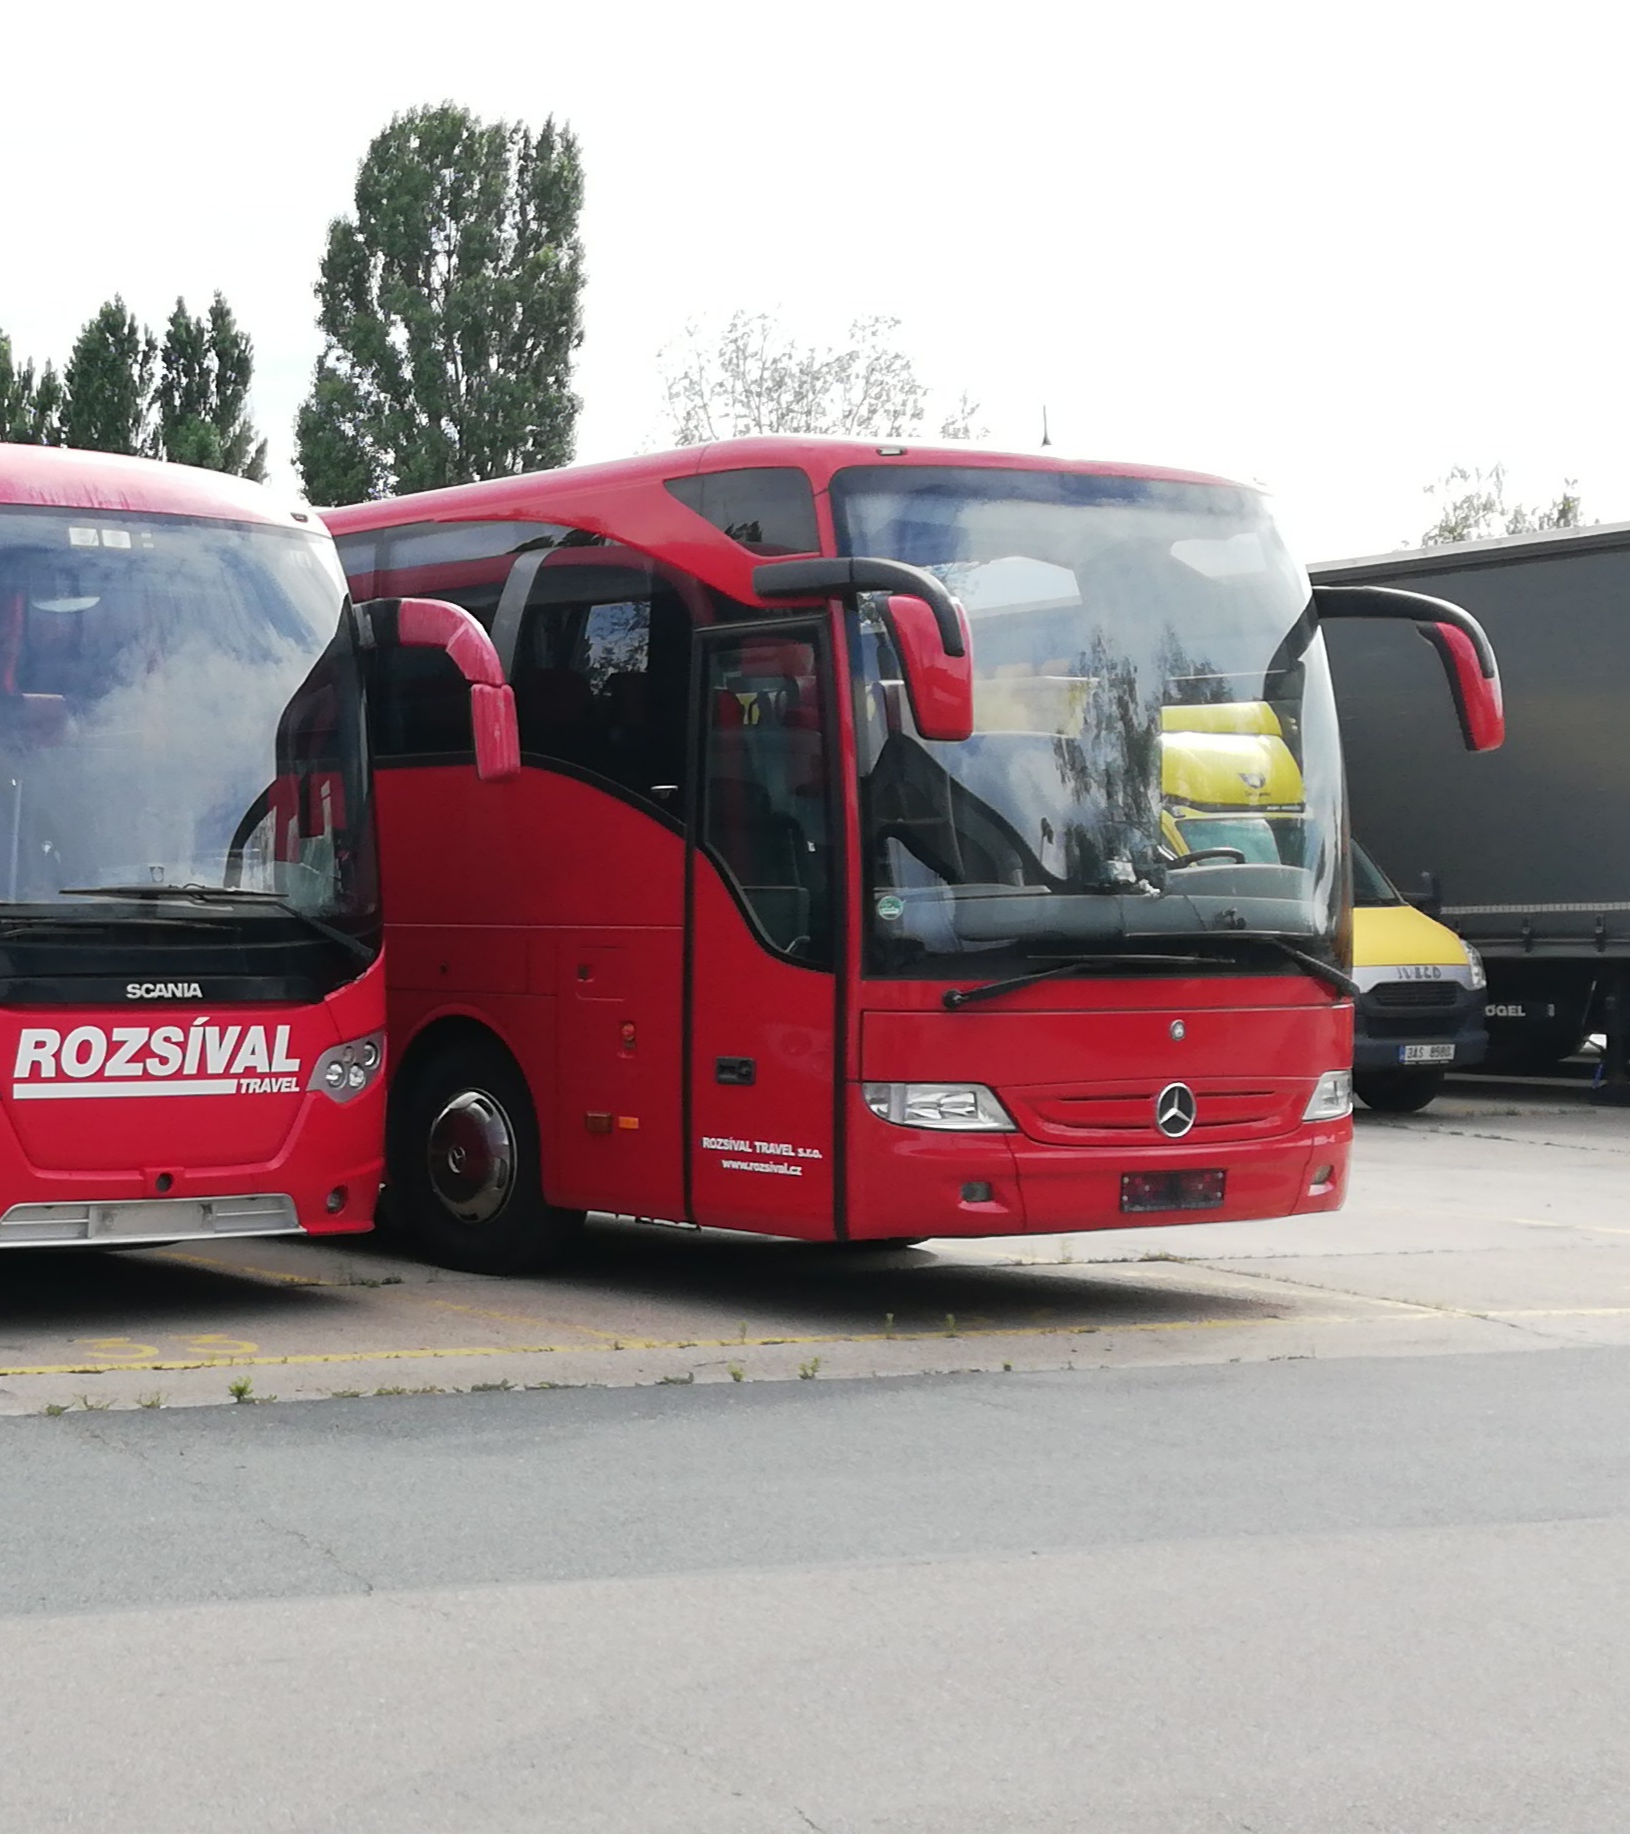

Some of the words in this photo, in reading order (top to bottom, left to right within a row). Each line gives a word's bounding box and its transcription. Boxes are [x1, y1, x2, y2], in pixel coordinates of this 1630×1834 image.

[126, 983, 203, 999] SCANIA
[13, 1016, 301, 1078] ROZSÍVAL
[239, 1077, 301, 1094] TRAVEL
[702, 1136, 752, 1153] ROZSÍVAL
[753, 1141, 796, 1156] TRAVEL
[797, 1148, 823, 1158] s.r.o.
[721, 1159, 803, 1176] www.rozsival.cz
